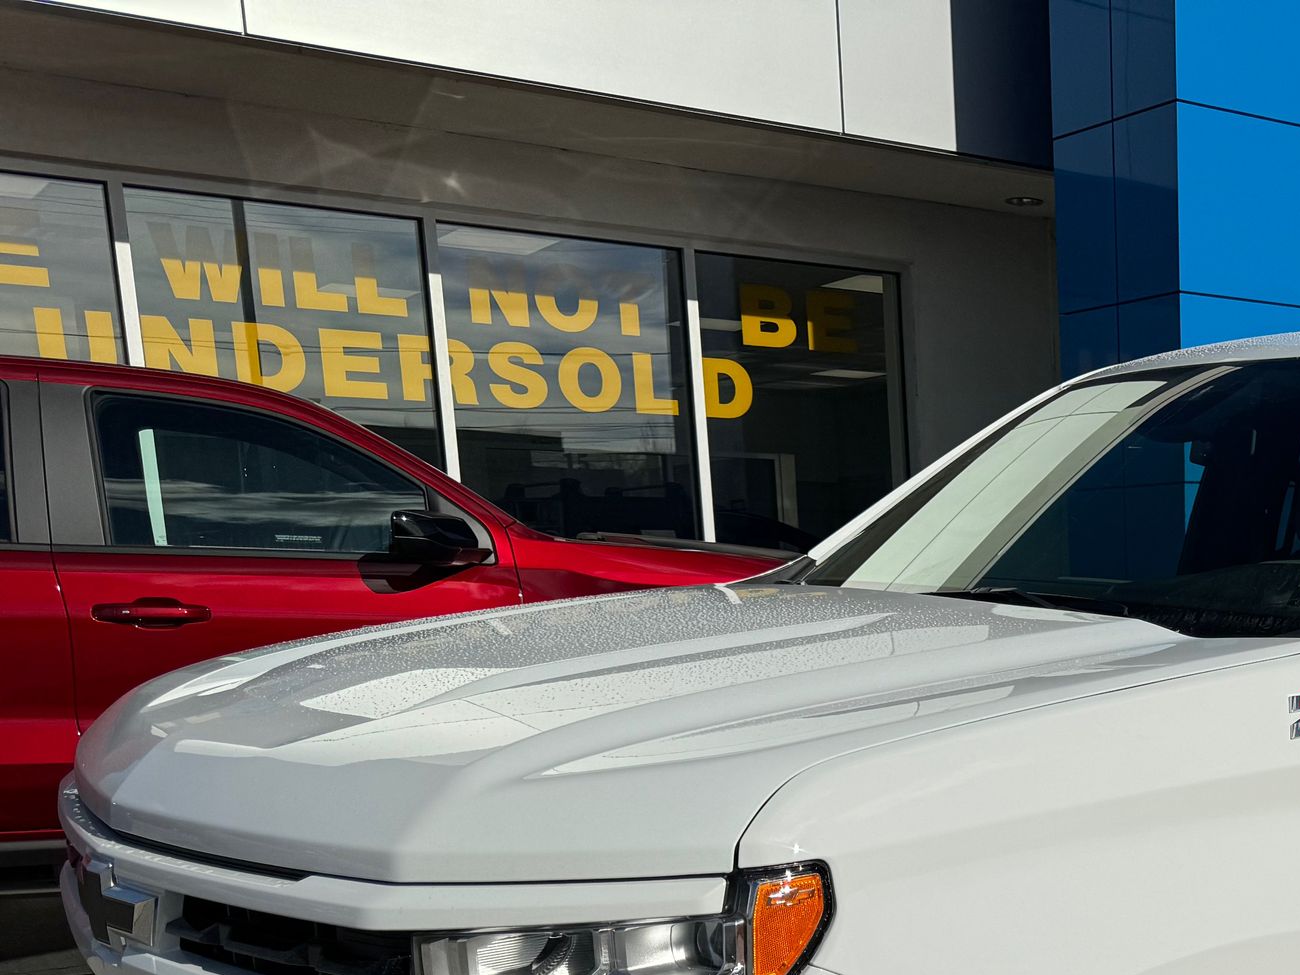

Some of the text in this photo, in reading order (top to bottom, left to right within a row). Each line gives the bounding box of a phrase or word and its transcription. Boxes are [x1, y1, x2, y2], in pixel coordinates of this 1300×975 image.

[148, 224, 408, 317] WILL
[467, 260, 653, 337] NOT
[739, 284, 859, 353] BE
[33, 307, 753, 419] UNDERSOLD
